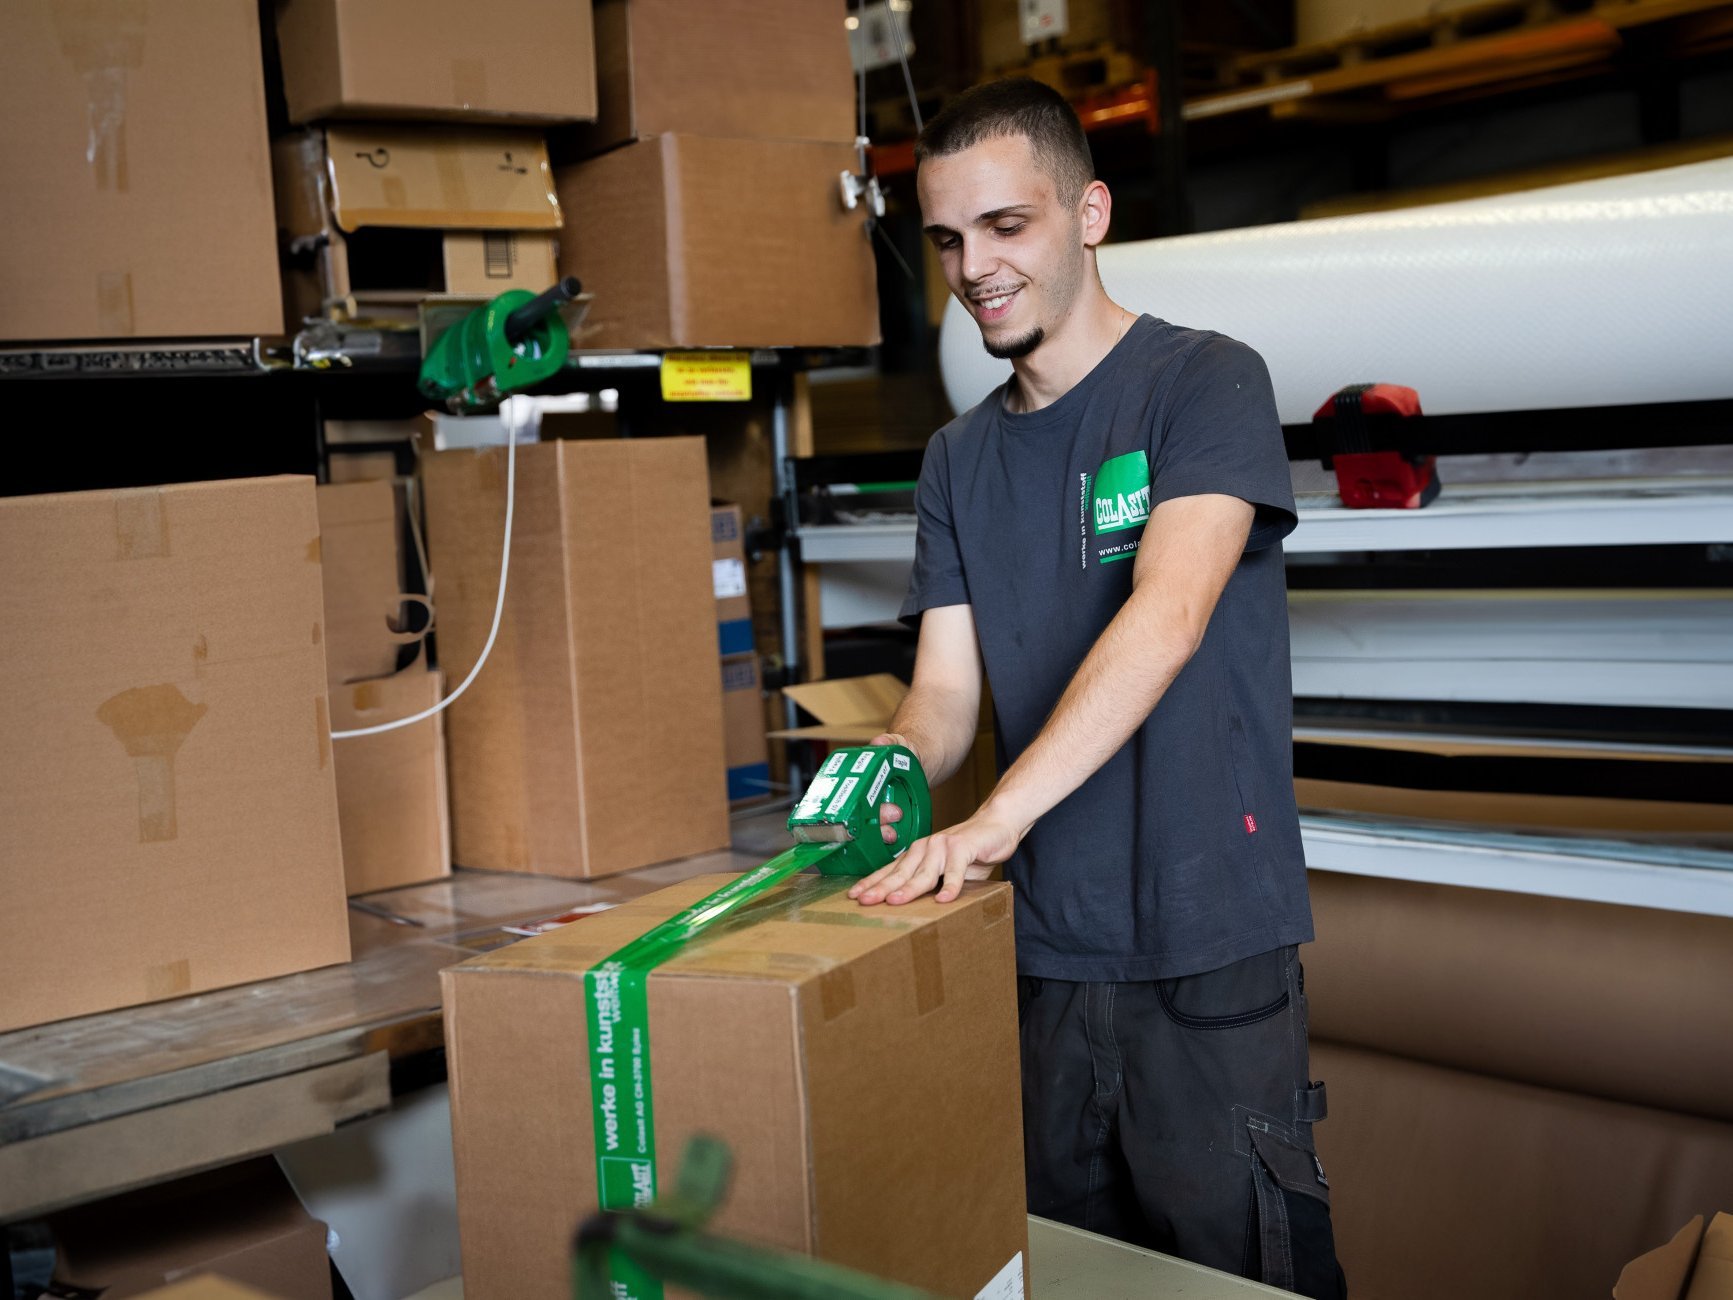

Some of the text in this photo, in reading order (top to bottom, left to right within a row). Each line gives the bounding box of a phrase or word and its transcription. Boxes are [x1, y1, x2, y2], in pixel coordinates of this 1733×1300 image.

[1096, 486, 1149, 526] COLASIT
[1081, 525, 1086, 535] in
[598, 1058, 615, 1079] in
[600, 1083, 619, 1151] werke
